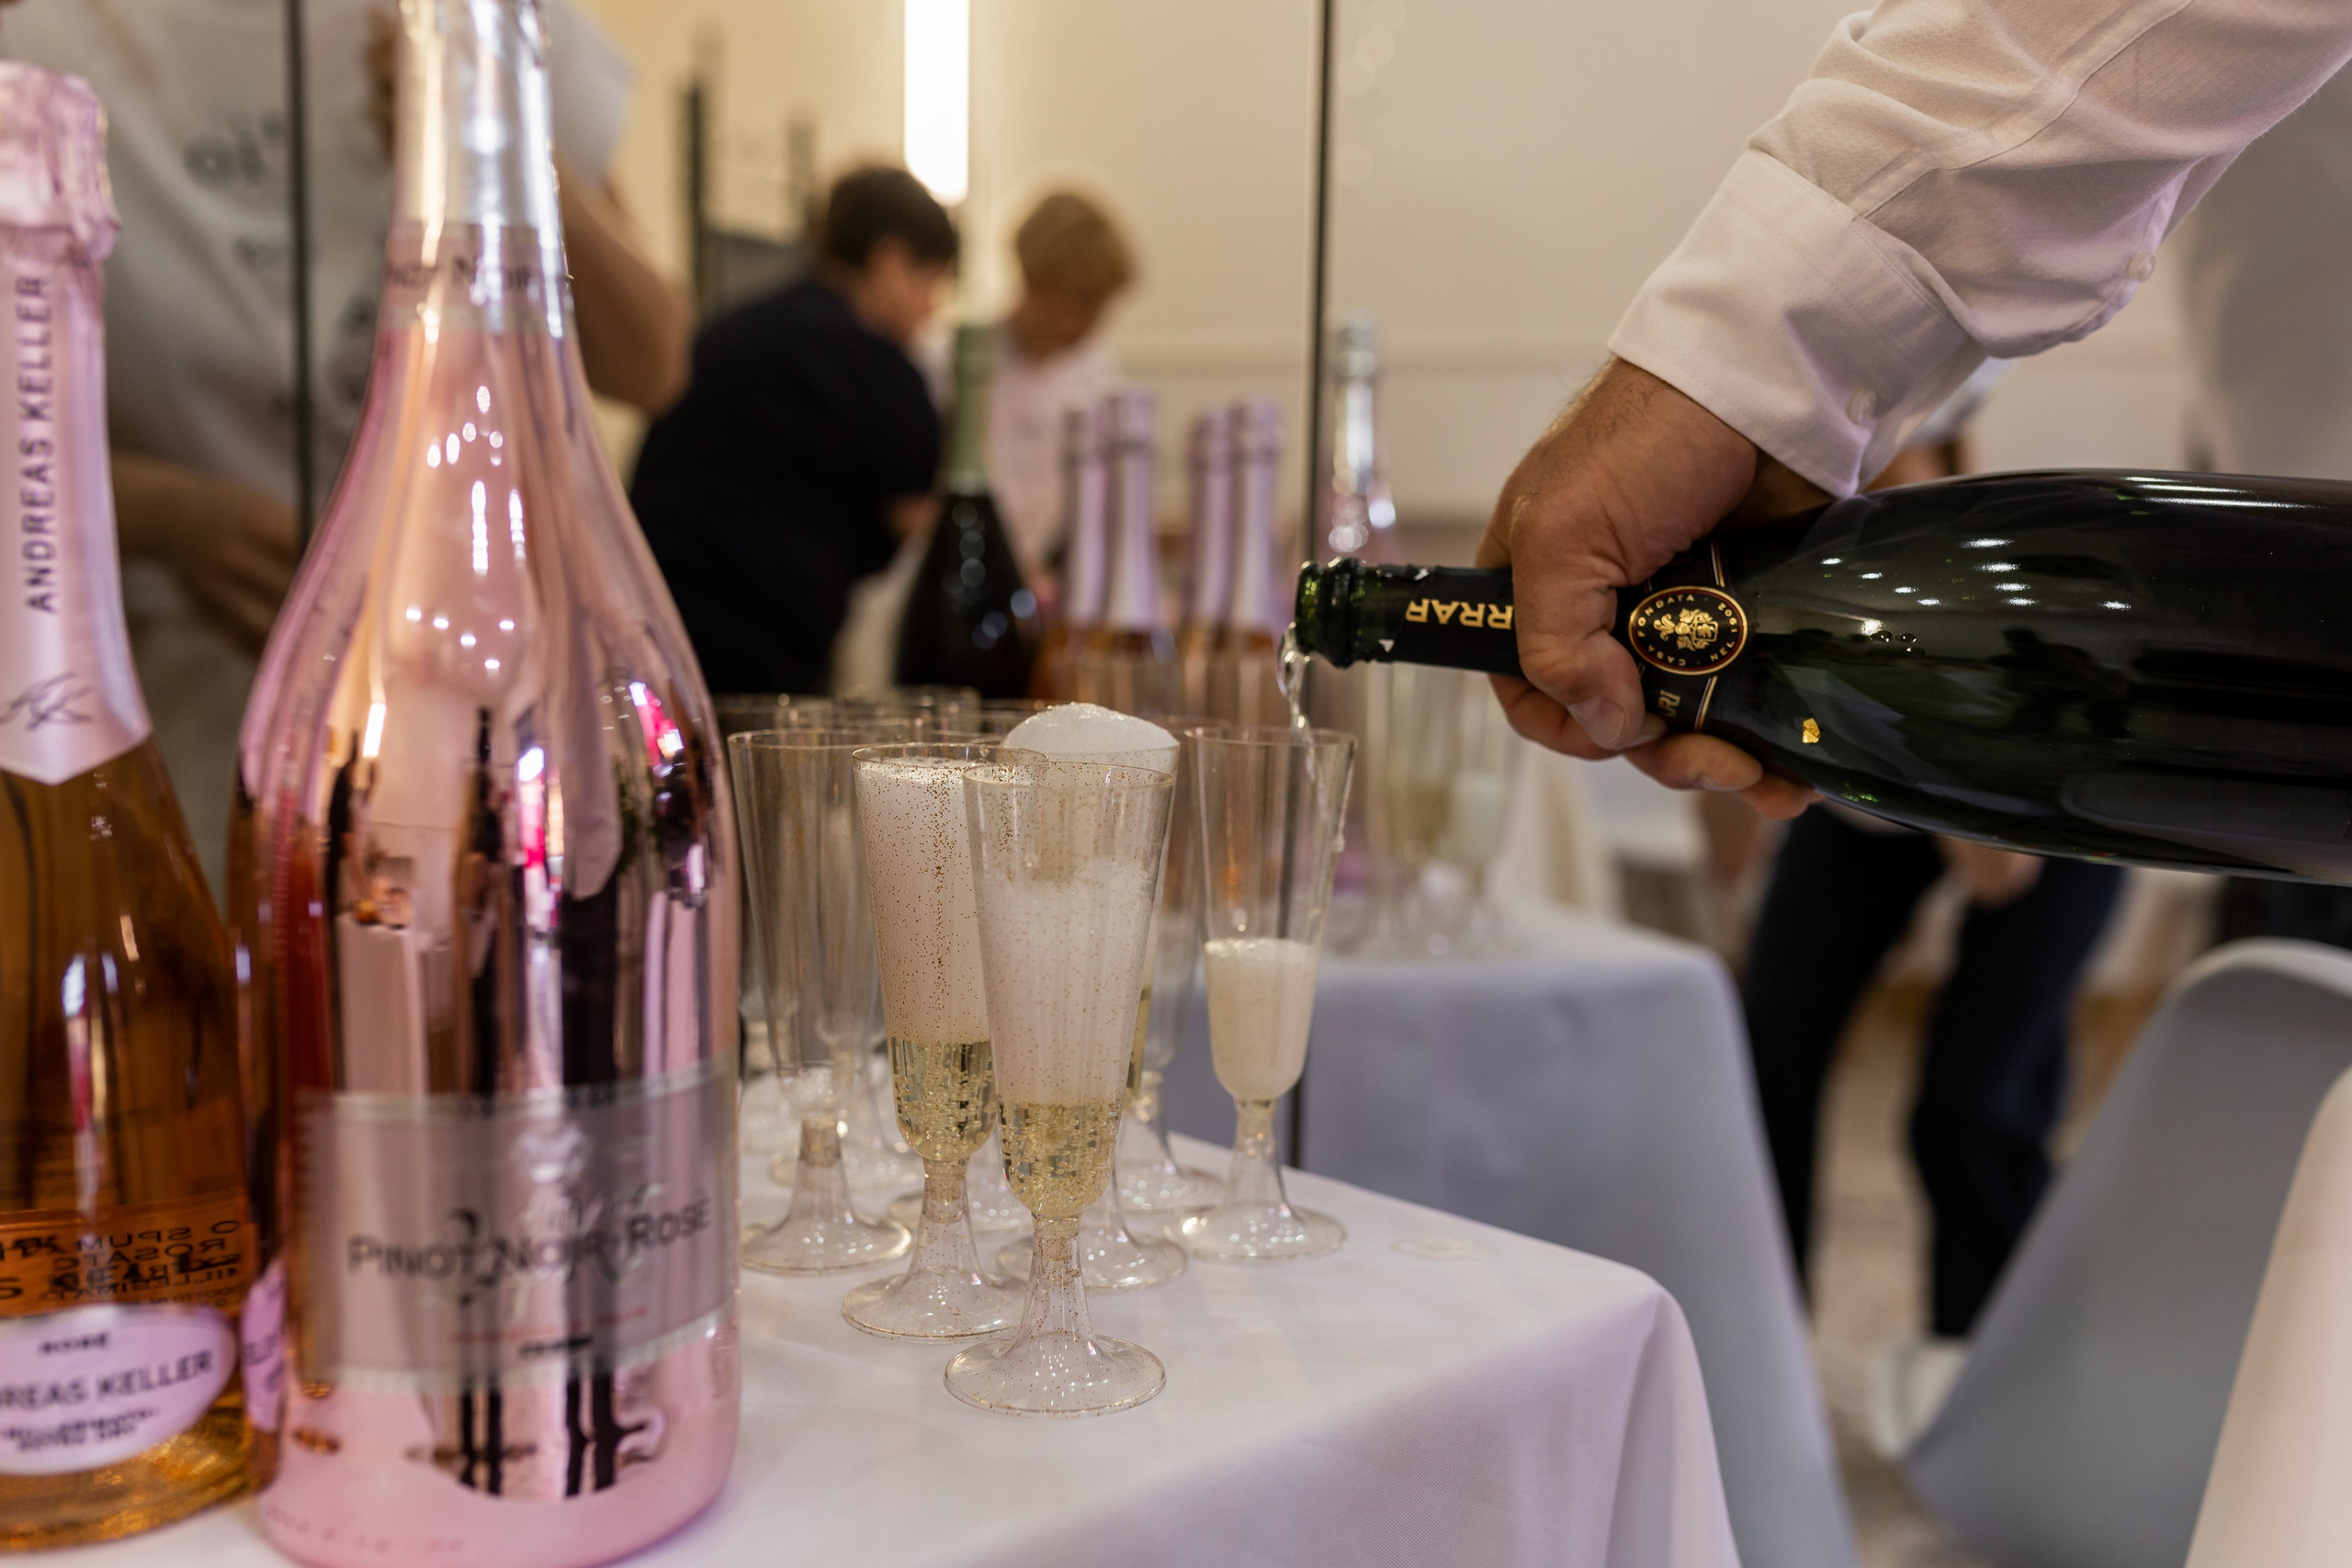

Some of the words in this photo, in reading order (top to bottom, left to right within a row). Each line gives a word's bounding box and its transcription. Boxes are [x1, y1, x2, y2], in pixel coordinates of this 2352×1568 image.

[16, 275, 52, 422] KELLER
[19, 439, 59, 614] ANDREAS
[1637, 593, 1694, 637] FONDATA
[1718, 603, 1737, 633] 1902
[1647, 643, 1686, 666] CASA
[1710, 640, 1735, 661] NEL
[96, 1348, 214, 1397] KELLER
